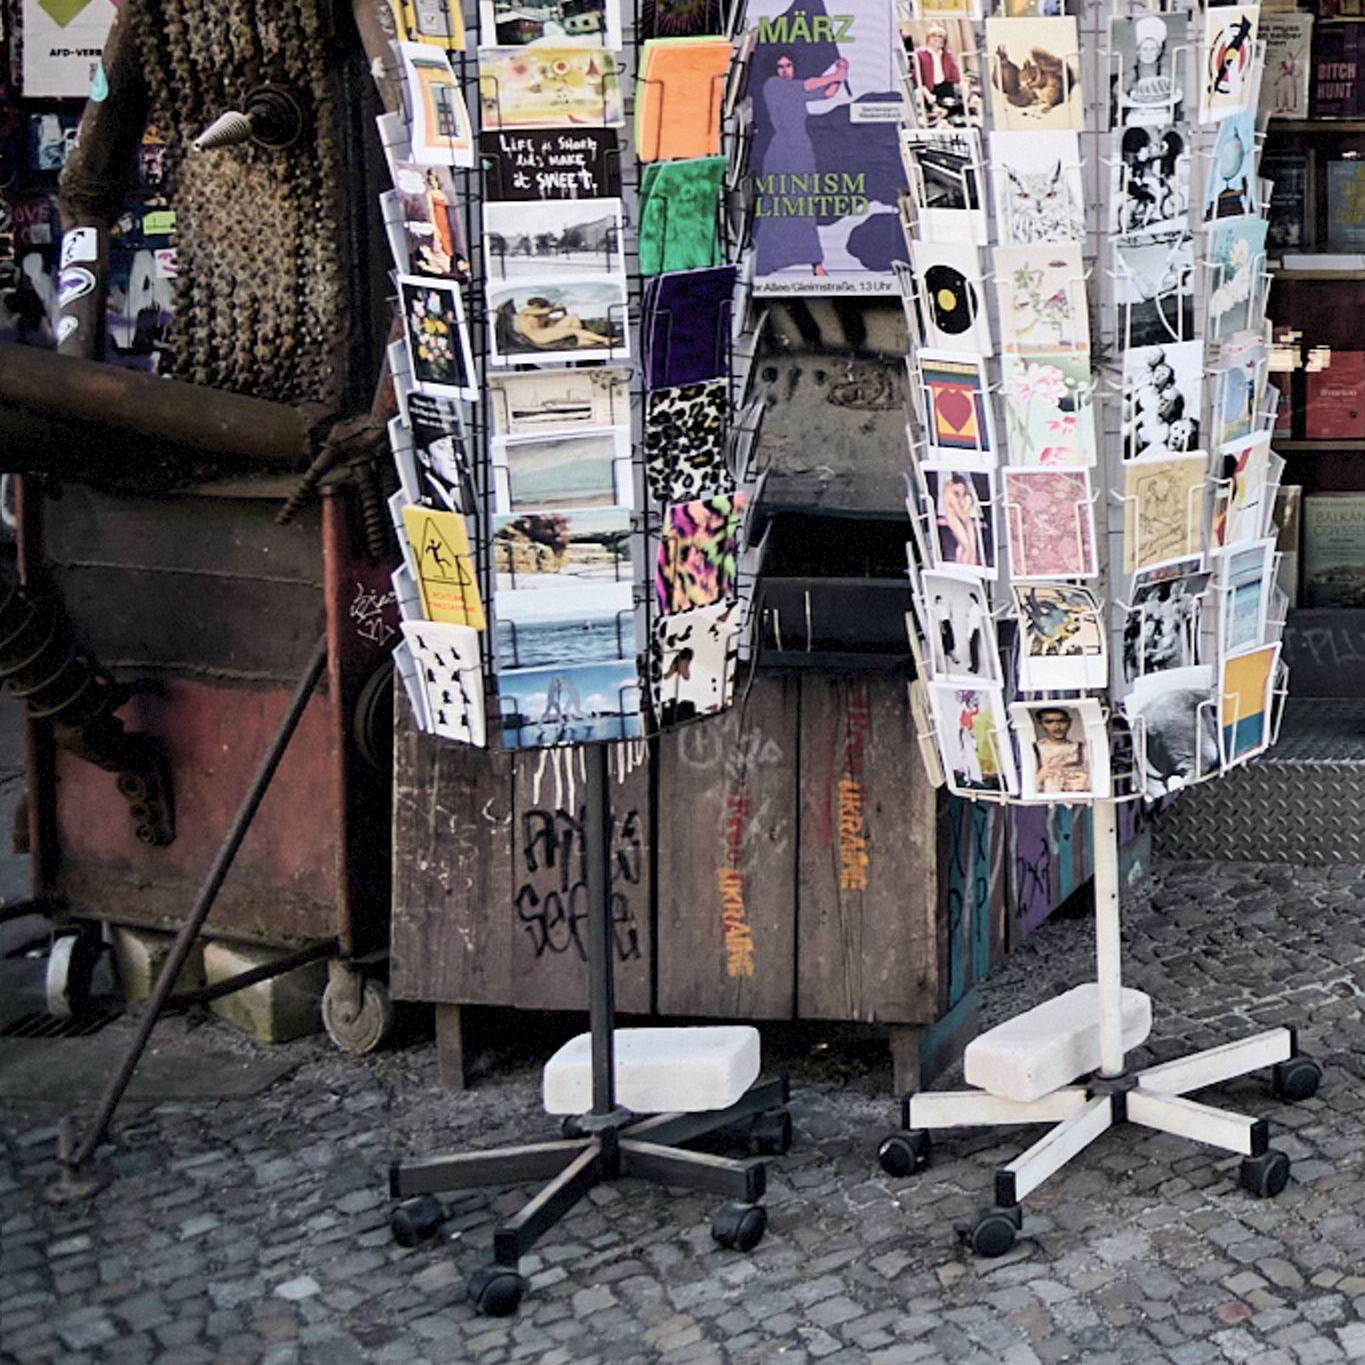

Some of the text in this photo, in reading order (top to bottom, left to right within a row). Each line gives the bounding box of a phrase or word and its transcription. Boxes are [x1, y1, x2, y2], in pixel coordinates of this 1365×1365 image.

[757, 9, 856, 45] MÄRZ
[1317, 62, 1356, 81] BITCH
[1316, 83, 1354, 100] HUNT
[754, 172, 867, 195] MINISM
[753, 194, 872, 218] LIMITED
